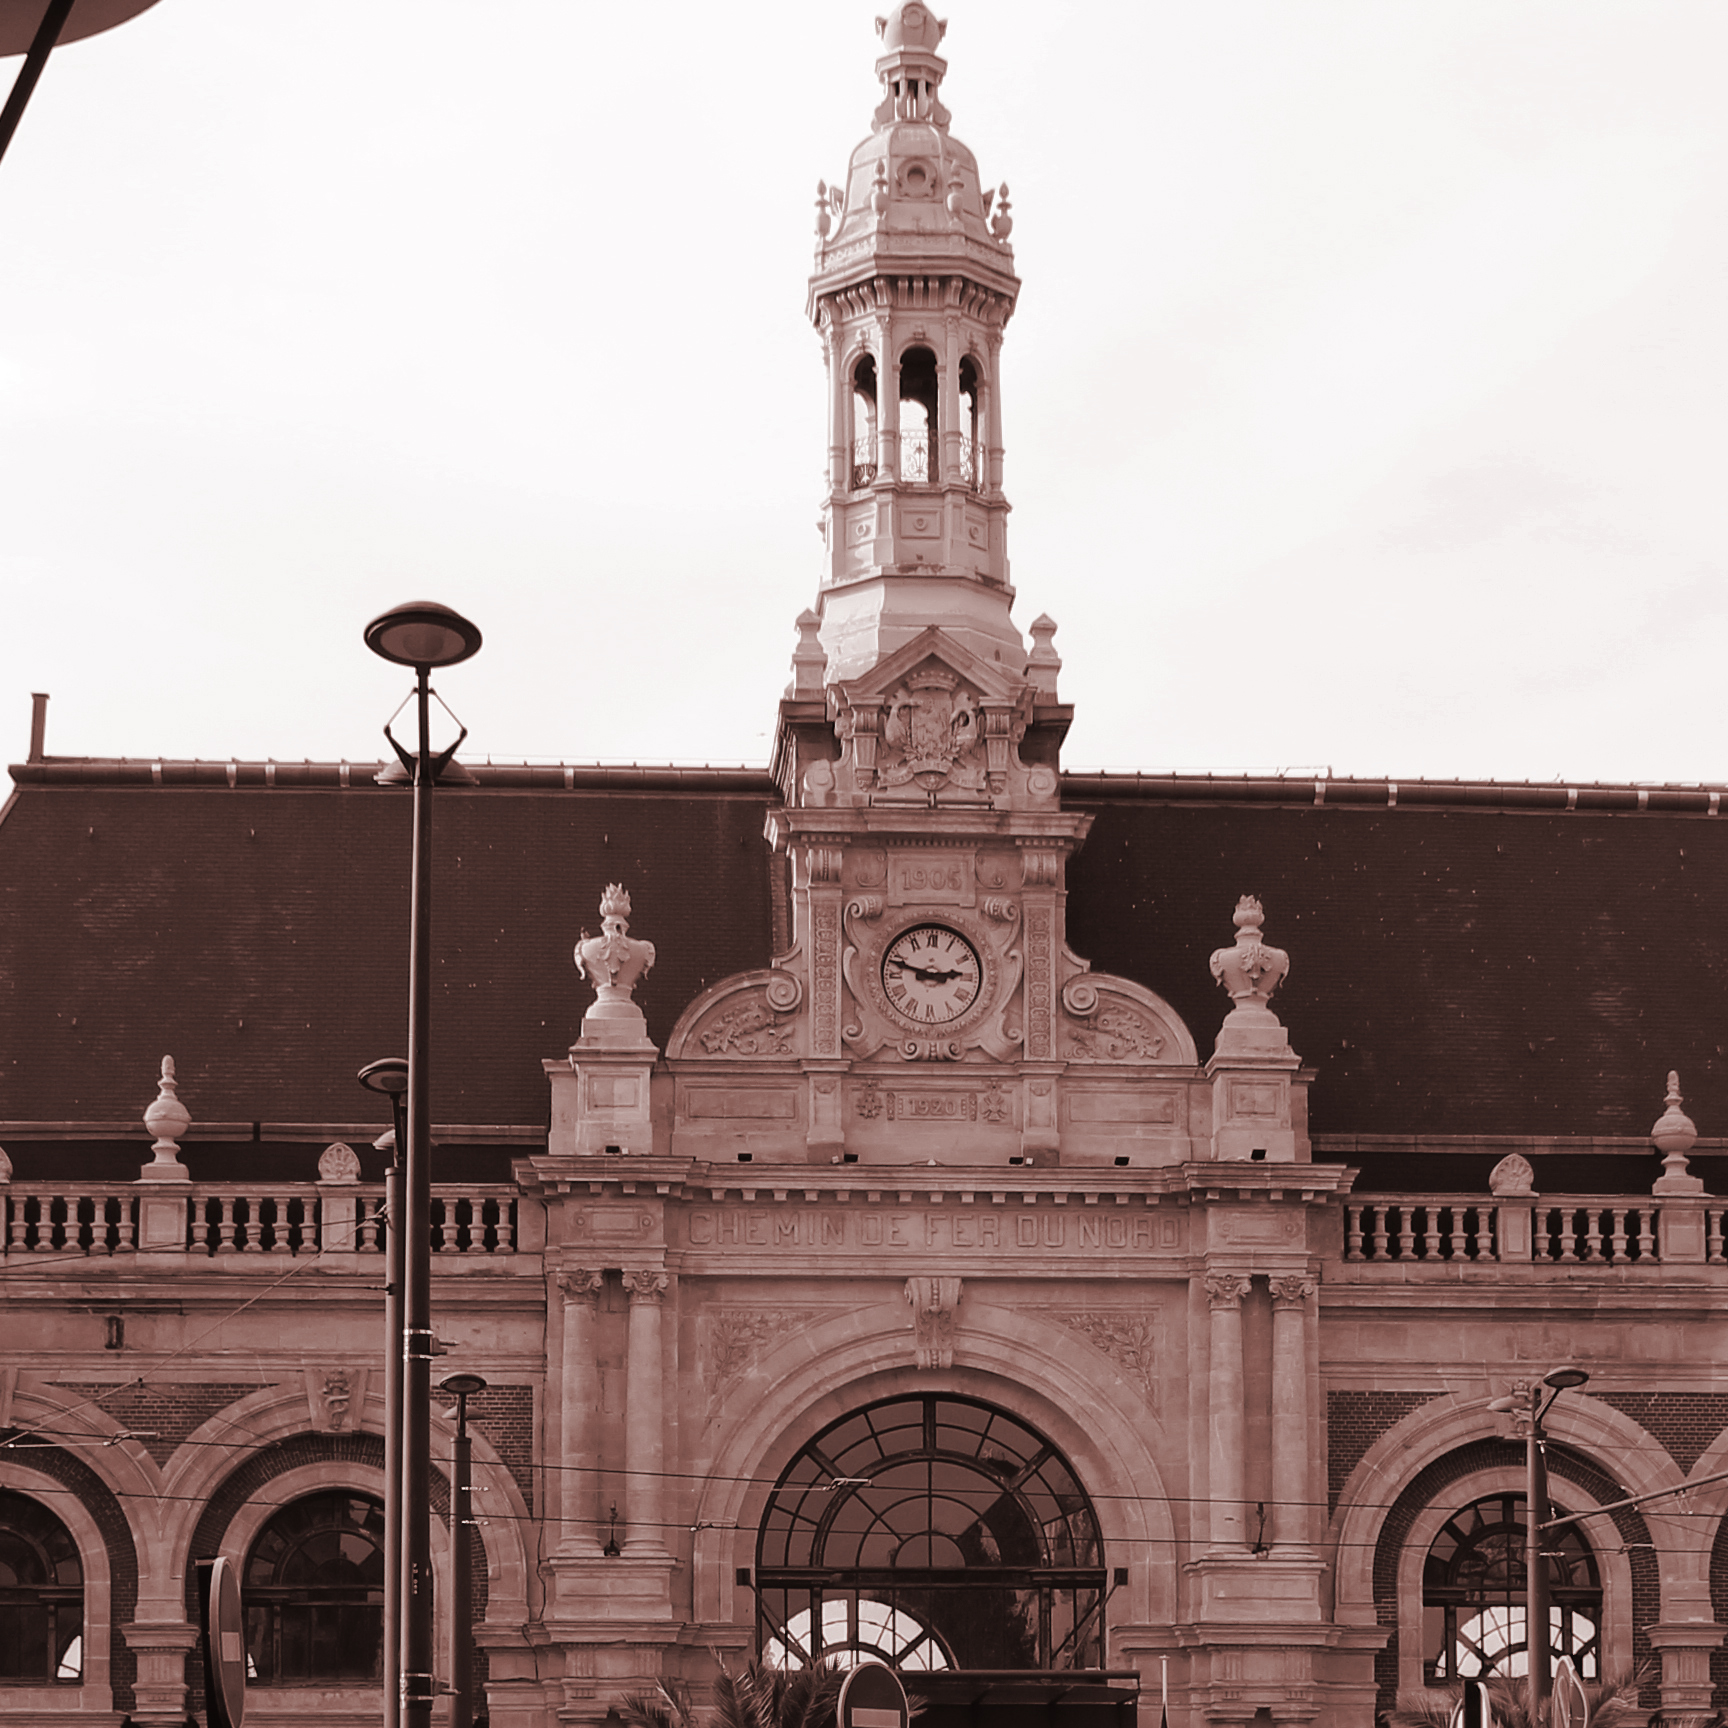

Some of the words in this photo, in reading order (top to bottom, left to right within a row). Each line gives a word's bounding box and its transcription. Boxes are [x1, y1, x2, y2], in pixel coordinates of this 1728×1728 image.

[901, 868, 962, 891] 1905
[908, 1098, 956, 1116] 1920
[688, 1212, 846, 1246] CHEMIN
[861, 1214, 909, 1247] DE
[924, 1214, 1000, 1247] FER
[1015, 1214, 1065, 1248] DU
[1077, 1214, 1181, 1249] NORD
